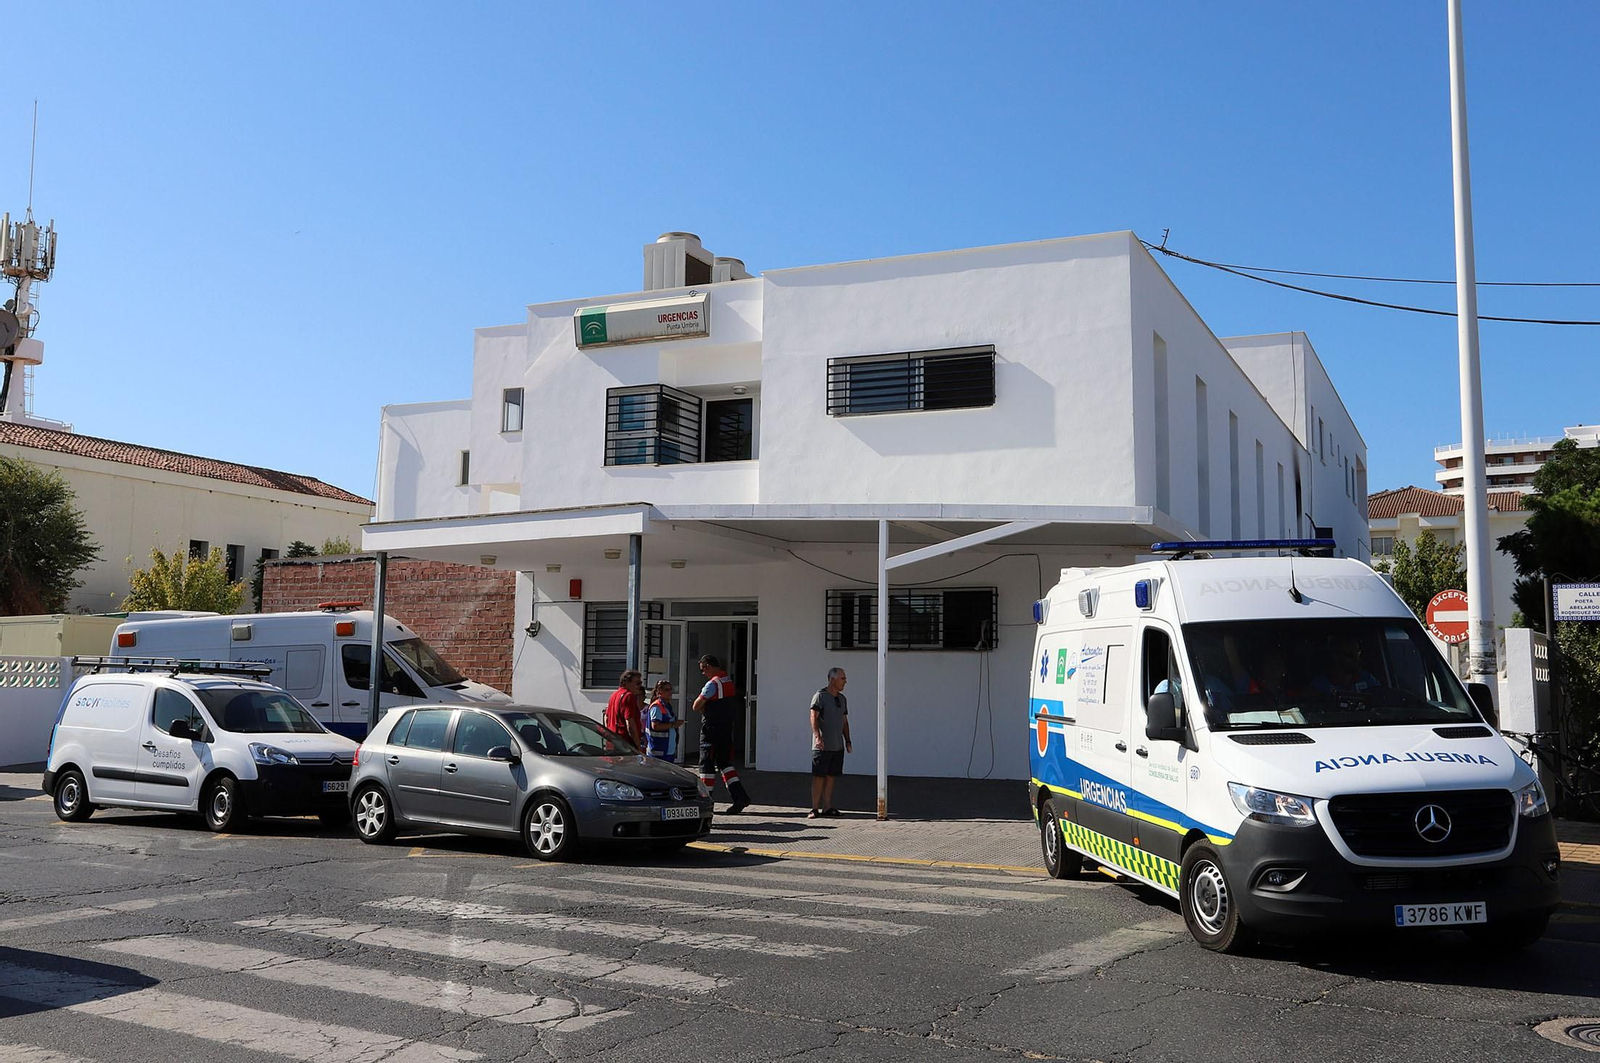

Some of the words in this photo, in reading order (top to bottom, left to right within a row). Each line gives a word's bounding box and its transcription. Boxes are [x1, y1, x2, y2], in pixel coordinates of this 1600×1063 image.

[658, 311, 698, 323] URGENCIAS
[152, 760, 186, 770] cumplidos
[327, 782, 345, 791] 6629
[1080, 777, 1127, 814] URGENCIAS
[666, 808, 685, 819] 0934
[1407, 906, 1449, 923] 3786
[1453, 904, 1483, 922] KWF
